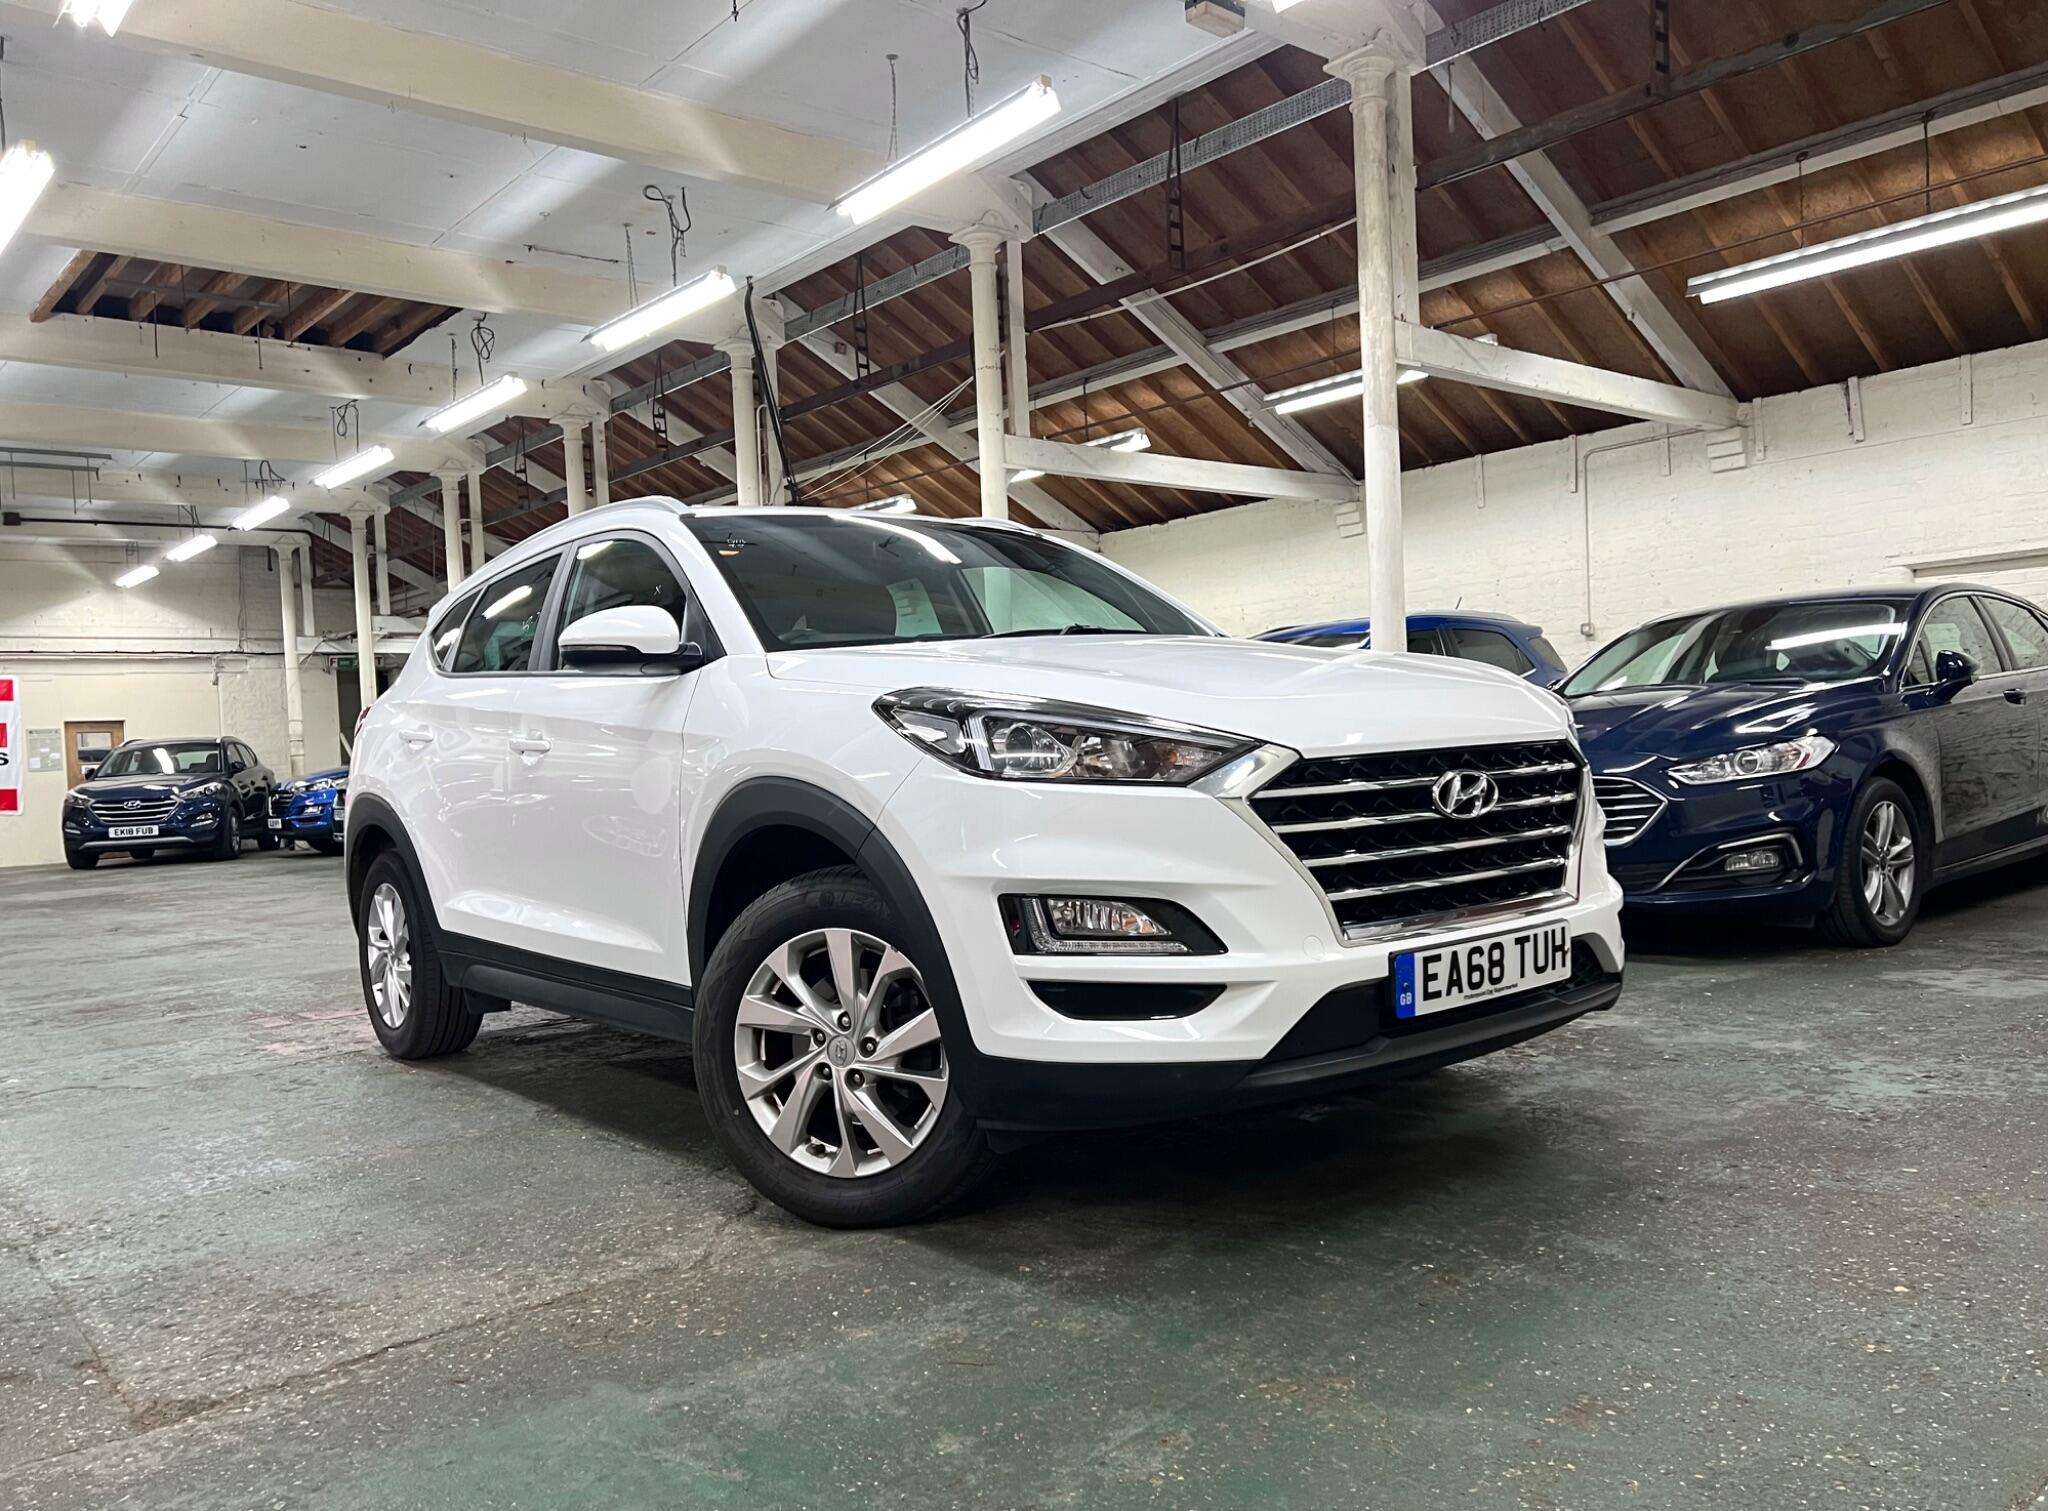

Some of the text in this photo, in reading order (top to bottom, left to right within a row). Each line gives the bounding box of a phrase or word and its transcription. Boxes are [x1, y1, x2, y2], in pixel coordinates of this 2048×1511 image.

[135, 826, 154, 835] FUB
[1422, 926, 1566, 1001] EA68 TUH
[1400, 992, 1412, 1006] GB
